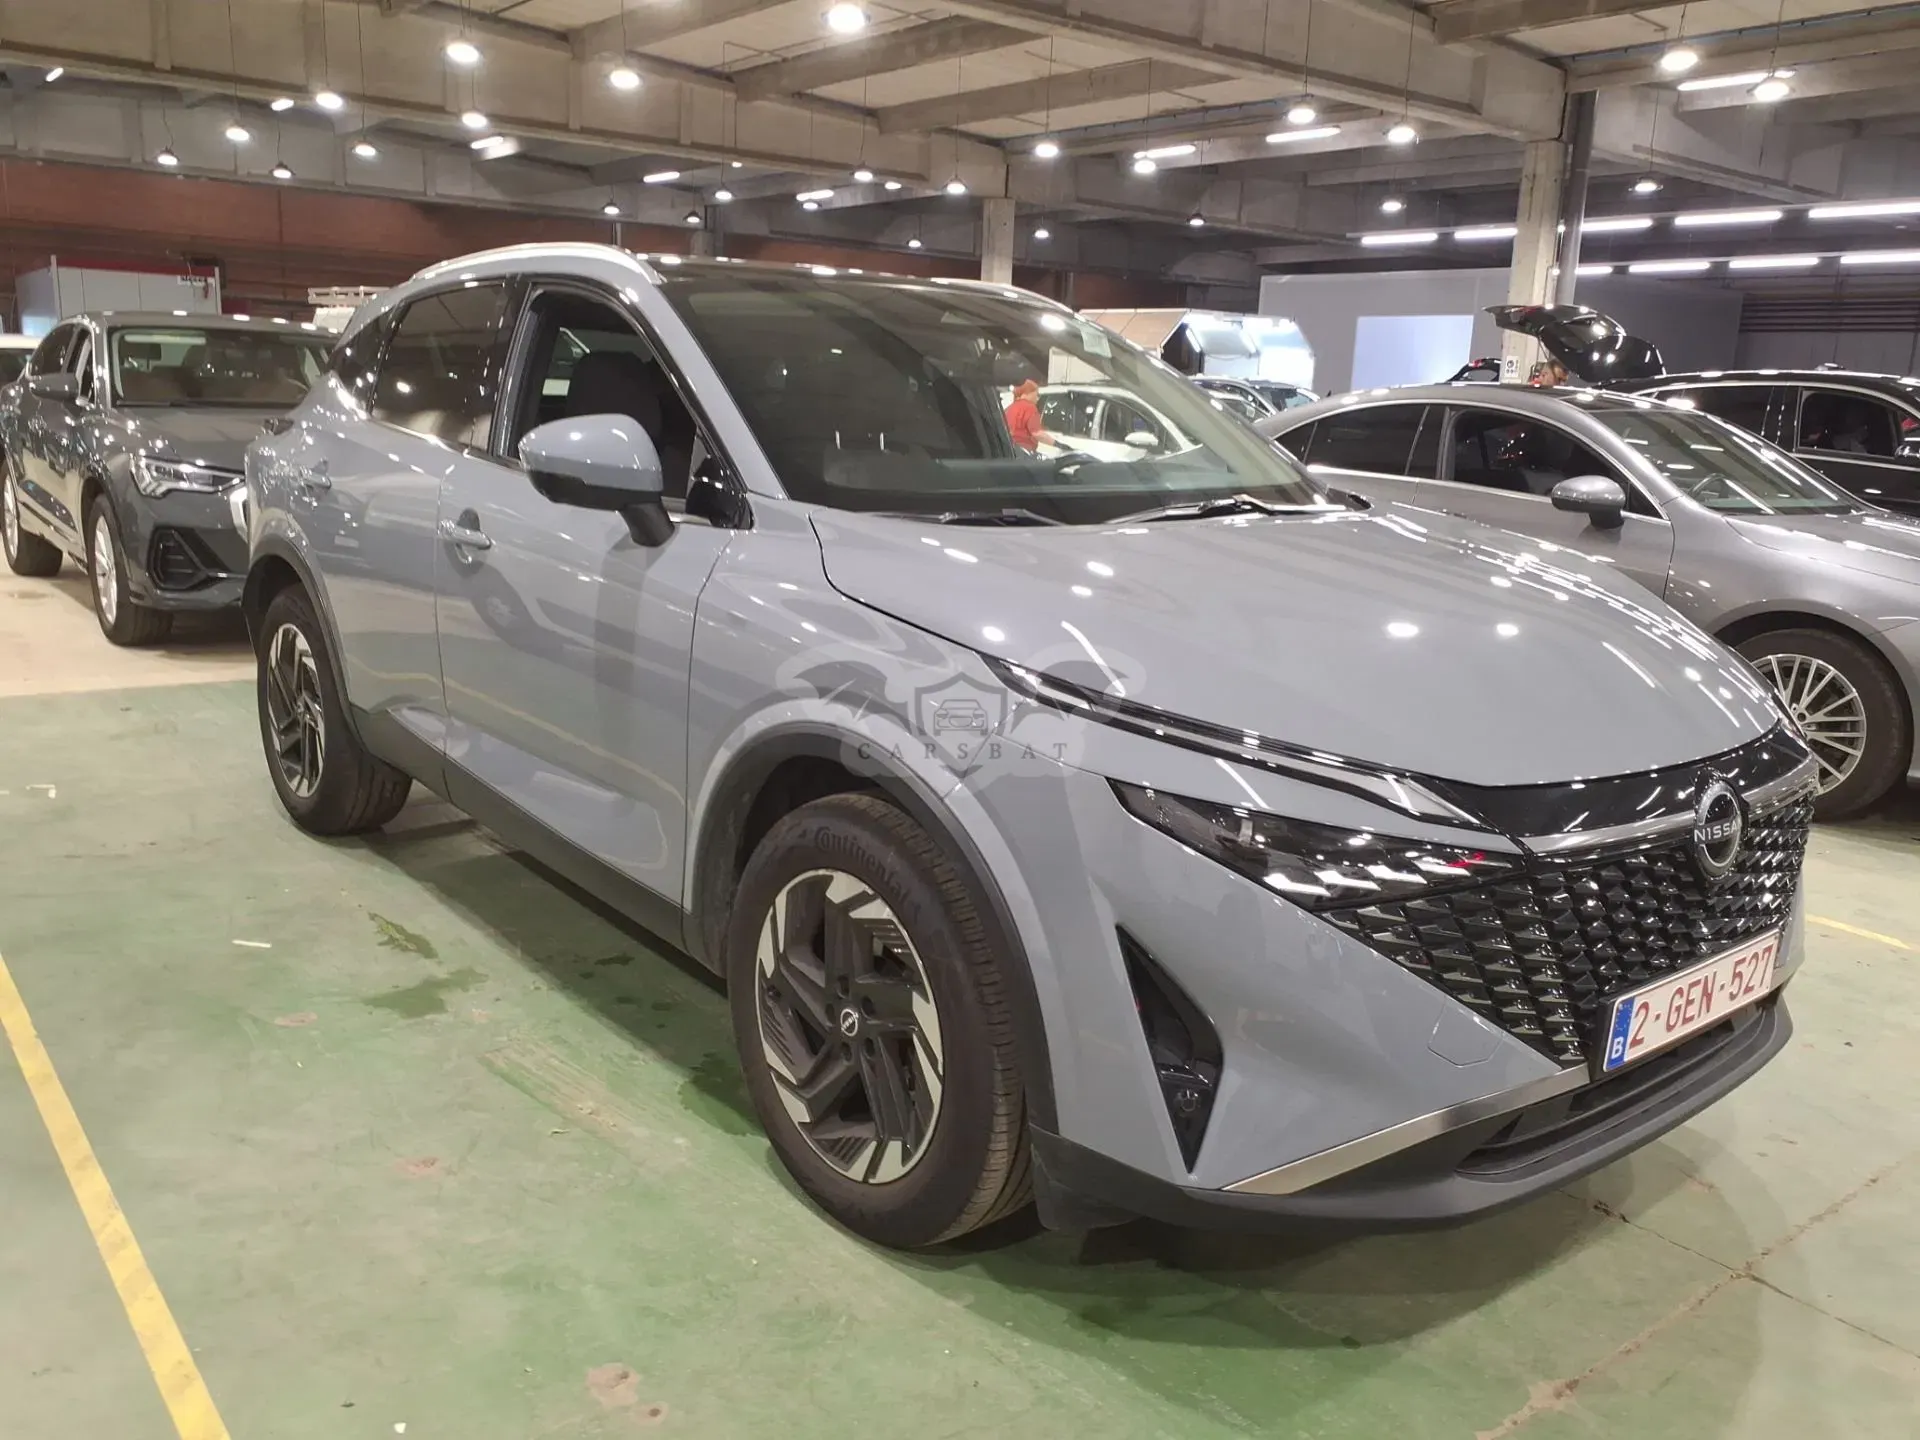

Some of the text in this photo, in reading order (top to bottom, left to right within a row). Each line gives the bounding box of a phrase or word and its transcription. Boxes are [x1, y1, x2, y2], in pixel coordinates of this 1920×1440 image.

[1694, 820, 1740, 842] NISSA
[1628, 942, 1774, 1049] 2-GEN-527
[1611, 1036, 1624, 1058] B
